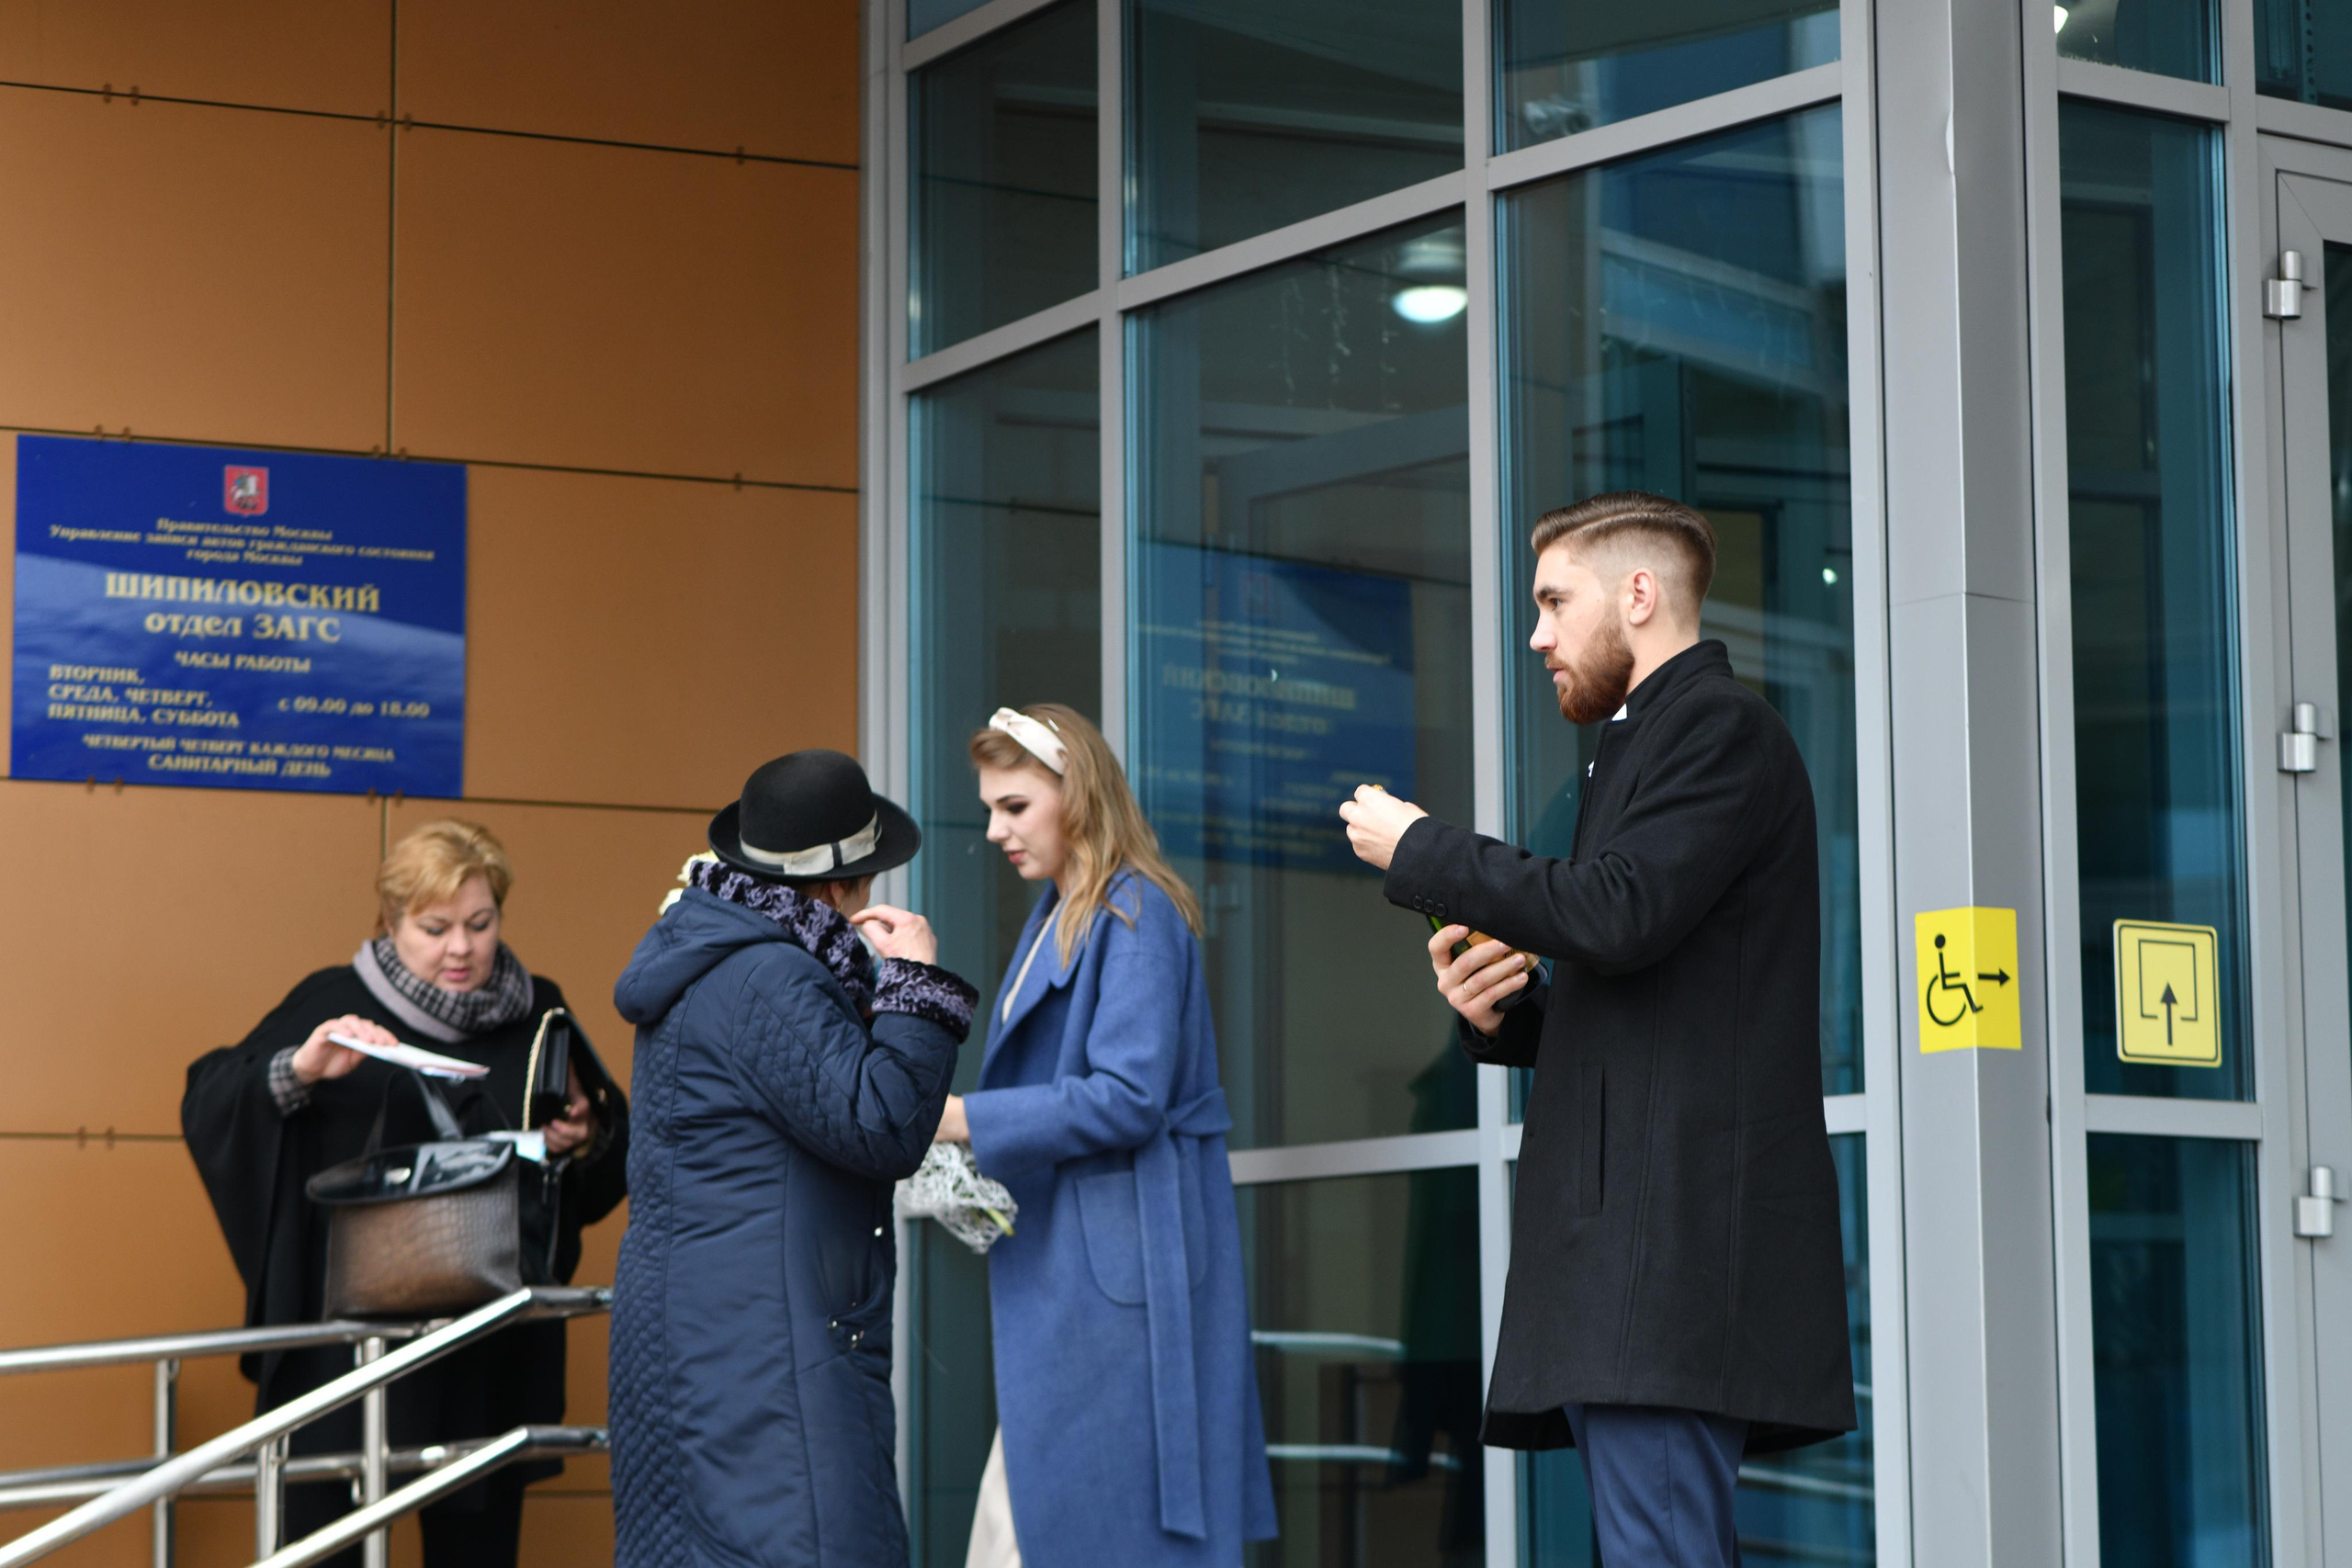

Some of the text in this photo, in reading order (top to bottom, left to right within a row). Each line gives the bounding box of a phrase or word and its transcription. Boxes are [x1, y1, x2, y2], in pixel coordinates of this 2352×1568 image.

[157, 518, 333, 541] Правительство Москвы
[50, 525, 435, 561] Управление записи актов гражданского состояния
[187, 548, 303, 567] города Москвы
[105, 571, 380, 613] ШИПИЛОВСКИЙ
[144, 613, 341, 643] отдел ЗАГС
[175, 650, 311, 673] ЧАСЫ РАБОТЫ
[49, 664, 145, 684] ВТОРНИК,
[49, 683, 213, 707] СРЕДА, ЧЕТВЕРГ,
[278, 696, 431, 718] с 09.00 до 18.00
[48, 703, 240, 728] ПЯТНИЦА, СУББОТА
[83, 733, 396, 762] ЧЕТВЕРТЫЙ ЧЕТВЕРГ КАЖДОГО МЕСЯЦА
[148, 754, 332, 778] САНИТАРНЫЙ ДЕНЬ
